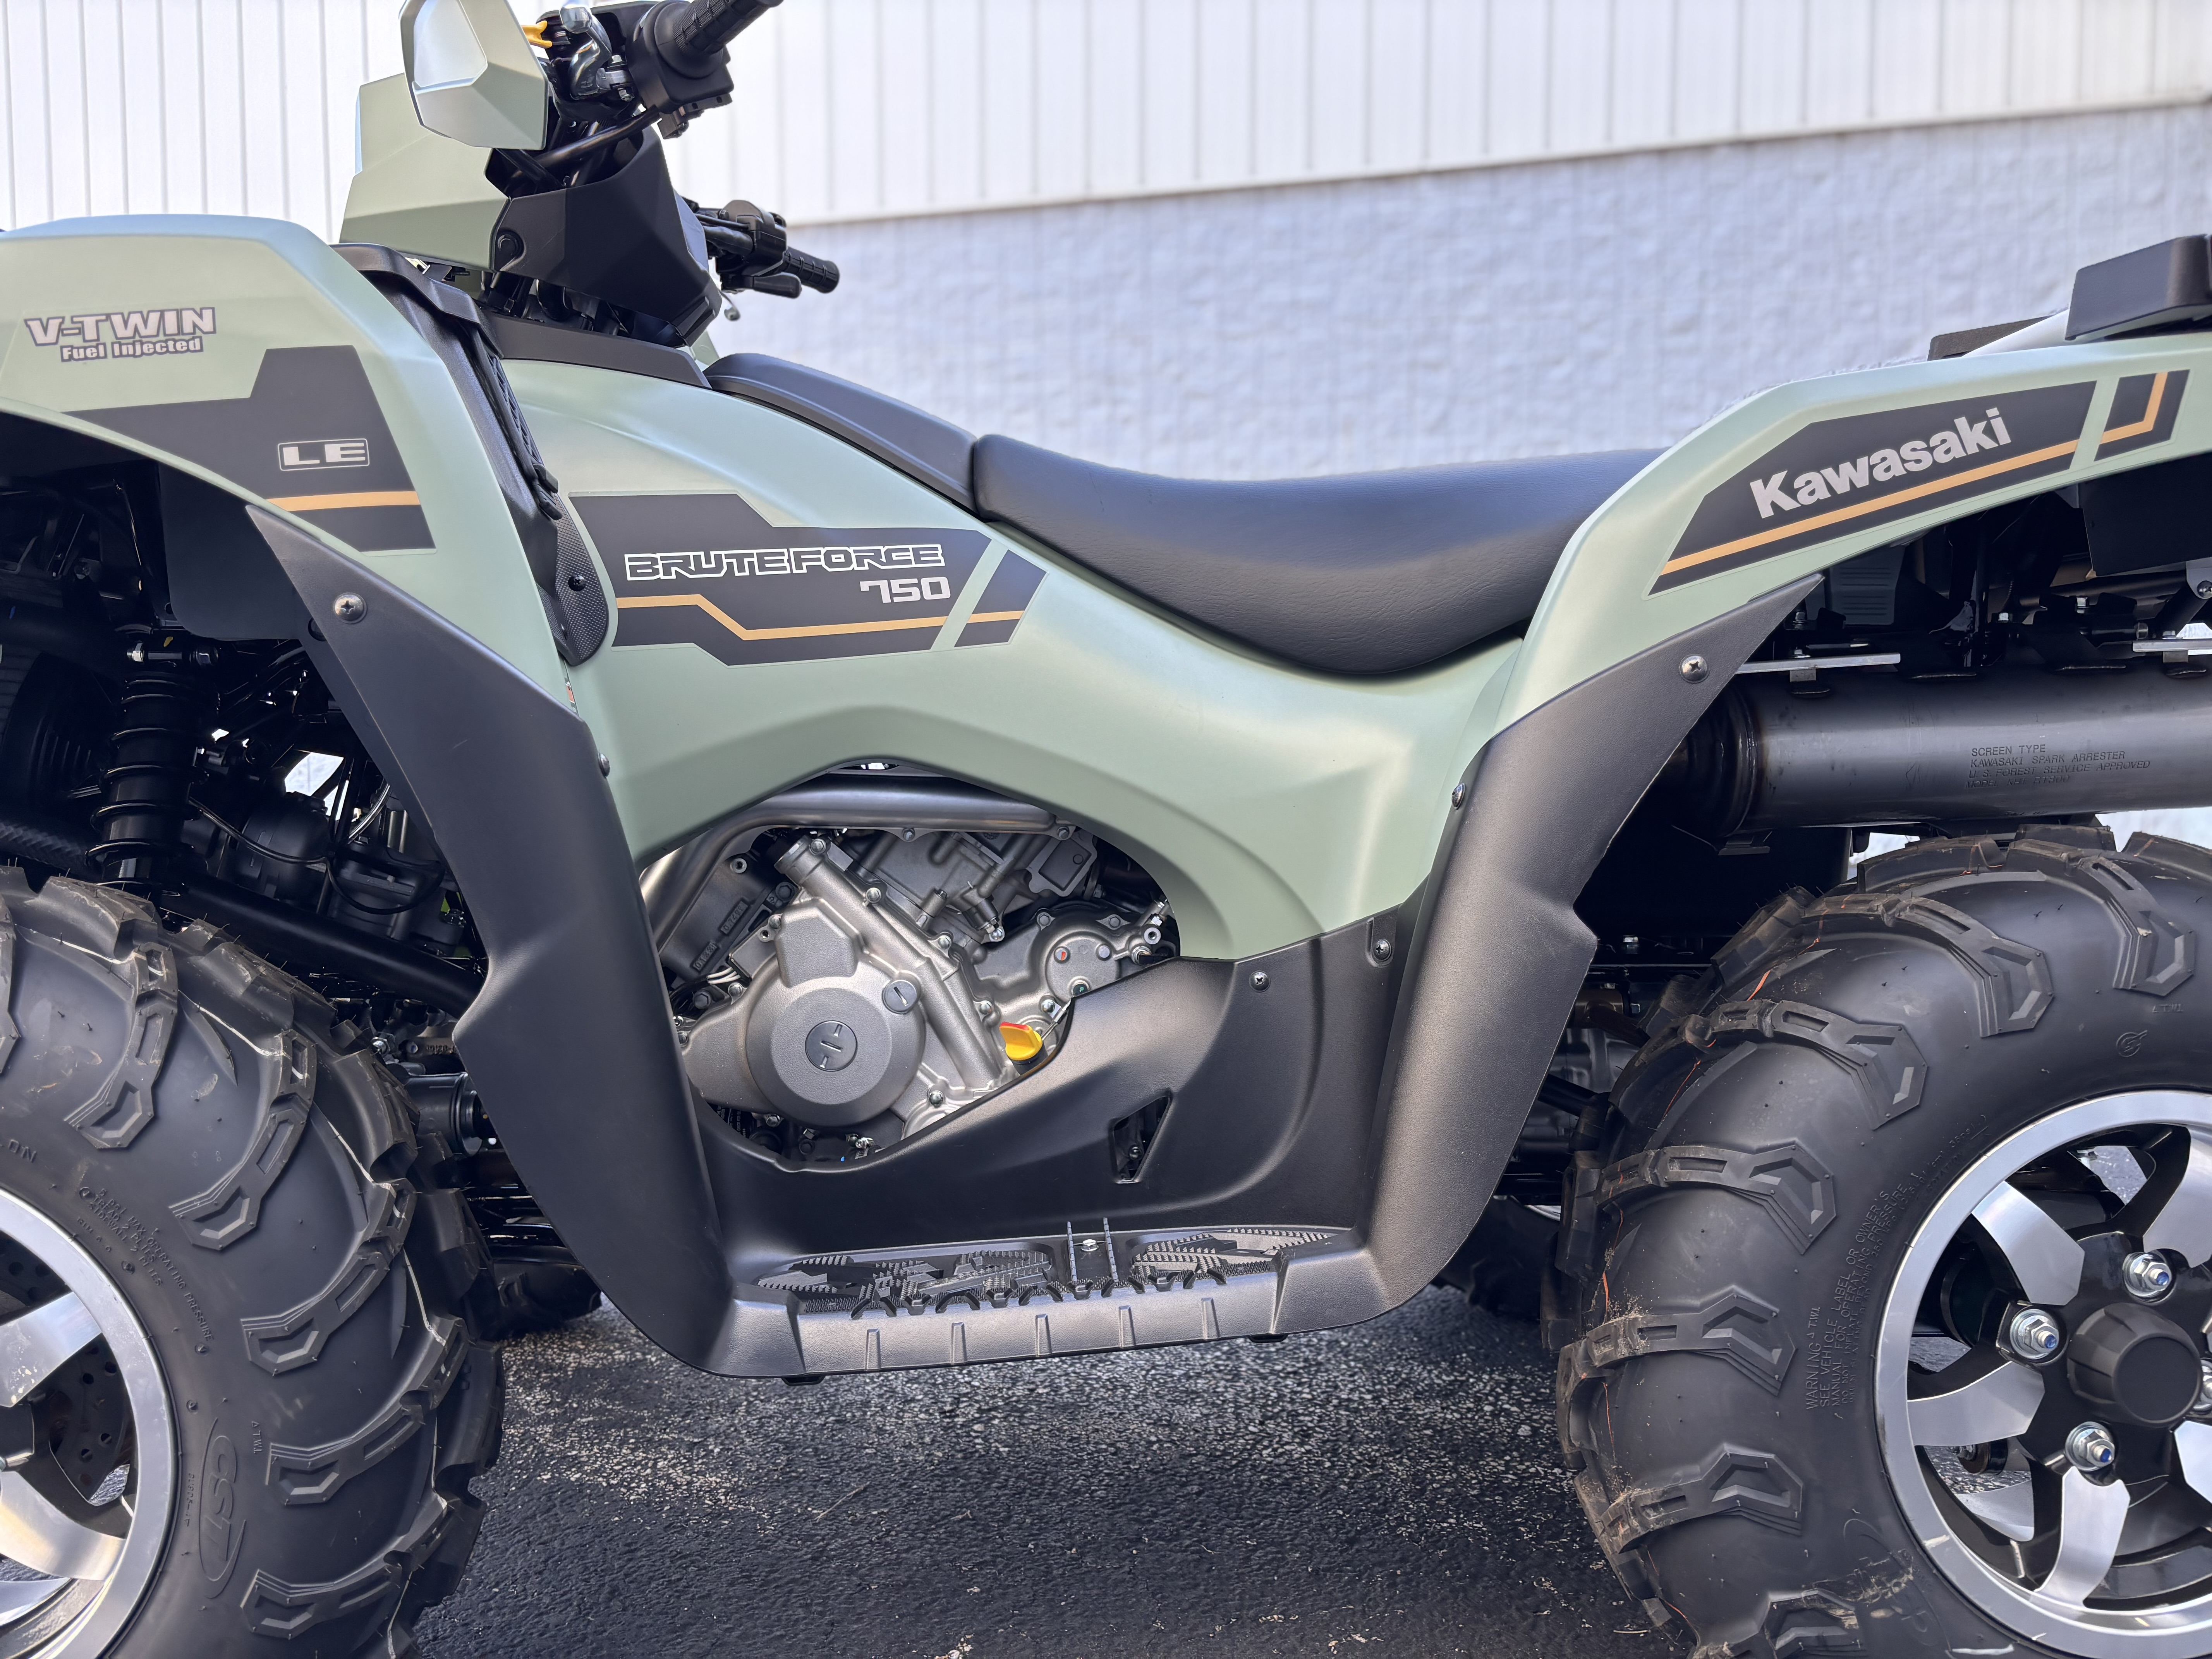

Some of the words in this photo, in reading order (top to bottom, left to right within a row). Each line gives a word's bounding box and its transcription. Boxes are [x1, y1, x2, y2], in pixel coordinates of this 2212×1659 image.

[24, 307, 217, 347] V-TWIN
[60, 342, 108, 363] Fuel
[111, 336, 203, 359] Injected
[282, 442, 366, 466] LE
[1749, 407, 2011, 519] Kawasaki
[860, 577, 951, 603] 750
[1970, 756, 2023, 768] KAWASAKI
[2032, 754, 2065, 764] SPARK
[2072, 751, 2125, 762] ARRESTER
[1971, 746, 2012, 756] SCREEN
[2018, 744, 2045, 754] TYPE
[1996, 767, 2037, 777] FOREST
[2044, 764, 2090, 774] SERVICE
[2096, 760, 2150, 771] APPROVED
[1846, 1249, 1859, 1264] OR
[1831, 1274, 1851, 1310] LABEL
[1841, 1247, 1870, 1317] OPERATING
[1820, 1319, 1837, 1374] VEHICLE
[1834, 1326, 1847, 1349] FOR
[1806, 1343, 1821, 1409] WARNING
[1831, 1358, 1842, 1406] MANUAL
[1820, 1383, 1830, 1407] SEE
